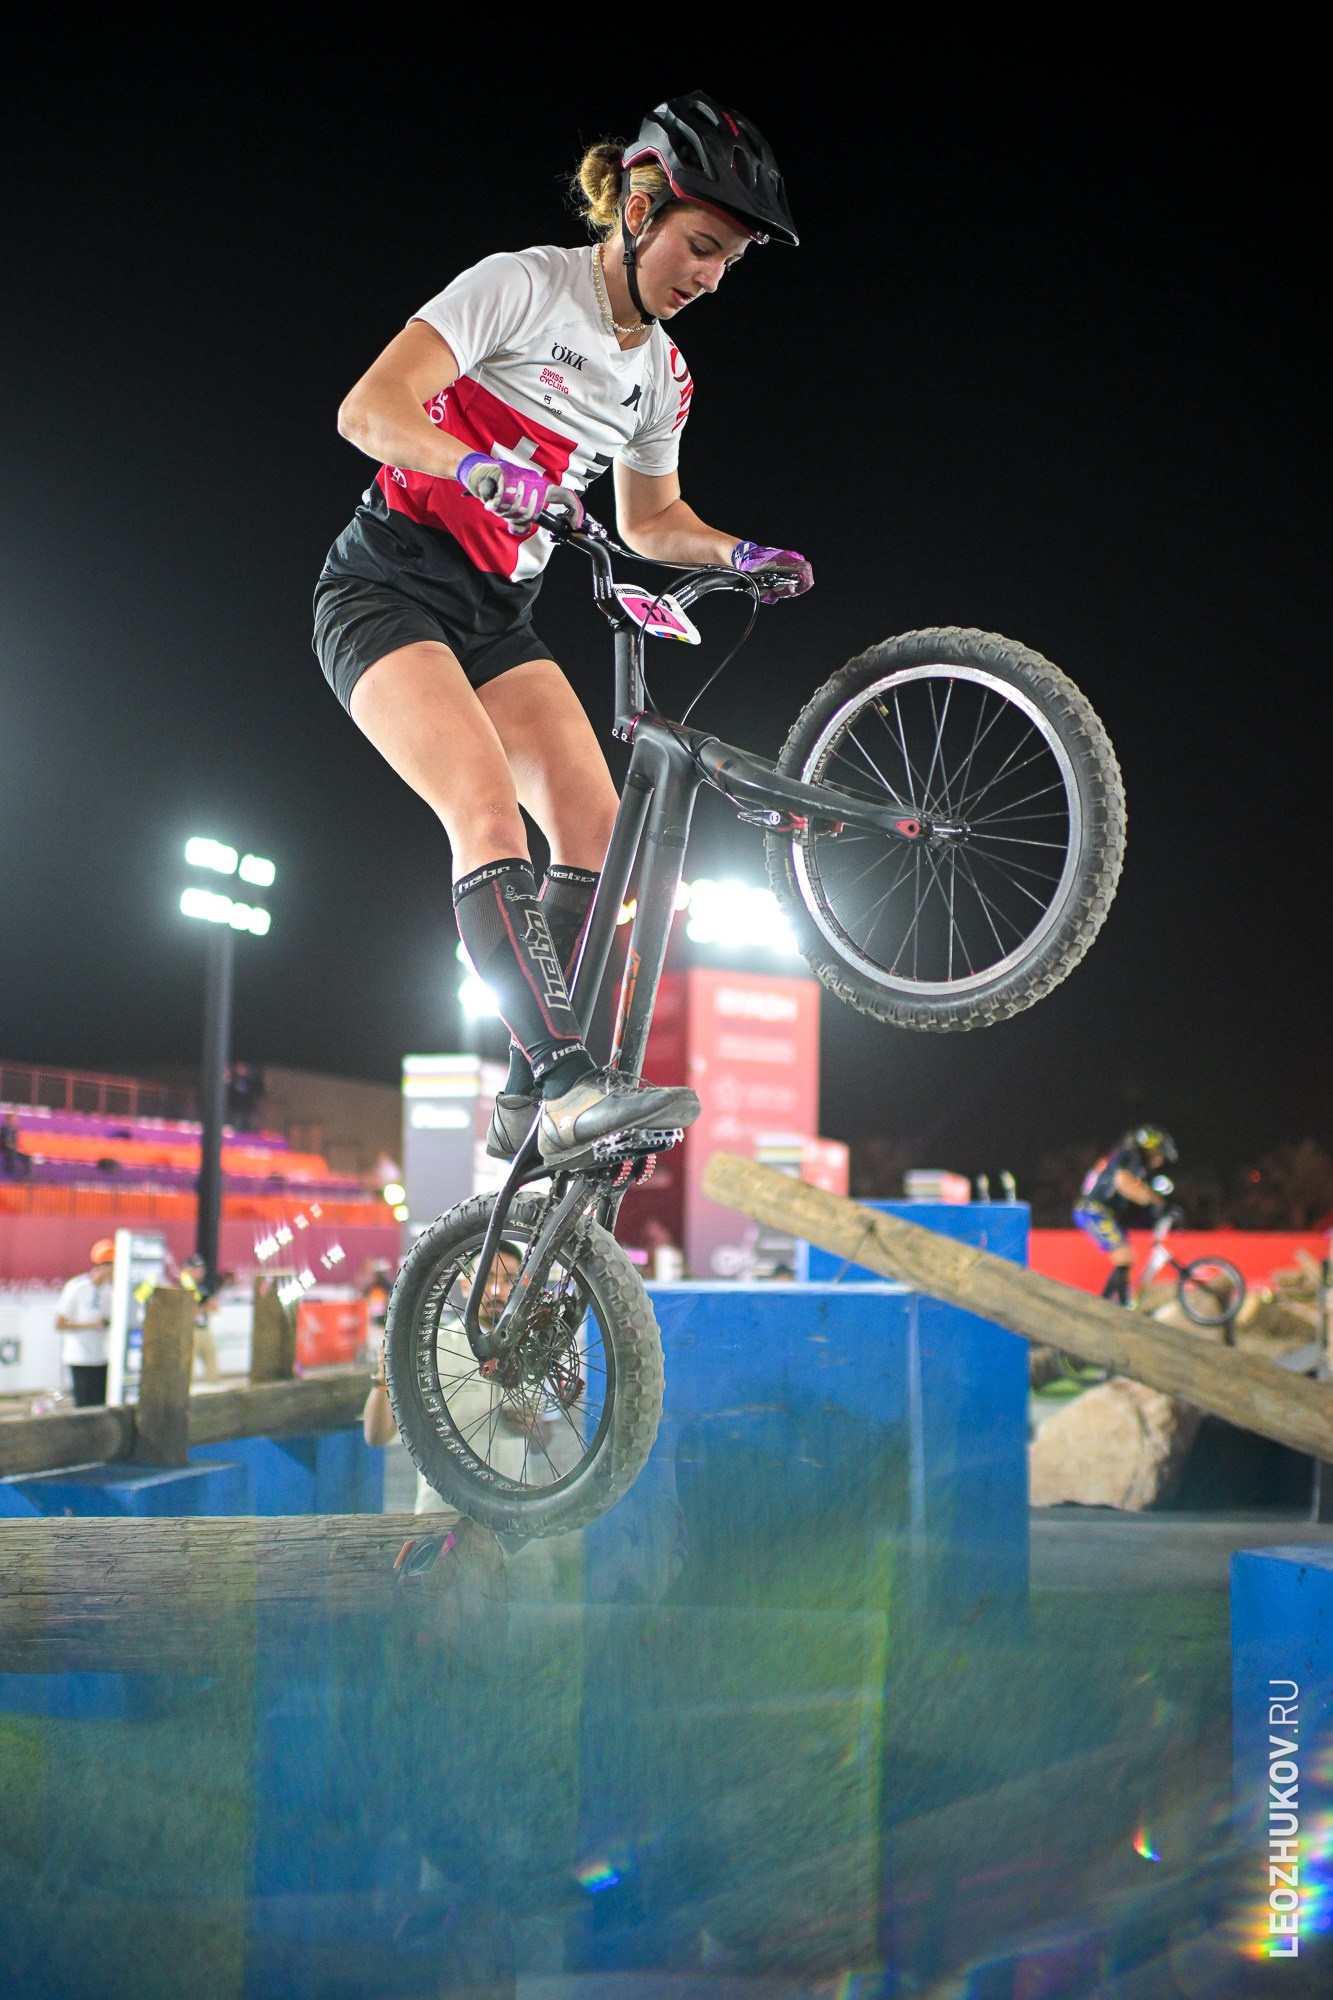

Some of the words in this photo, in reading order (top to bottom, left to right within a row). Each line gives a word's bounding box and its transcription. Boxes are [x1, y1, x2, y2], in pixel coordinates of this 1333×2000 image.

[551, 342, 588, 371] ÖKK
[539, 375, 569, 395] CYCLING
[542, 367, 564, 384] SWISS
[458, 865, 510, 894] hebo
[550, 869, 596, 883] hebo
